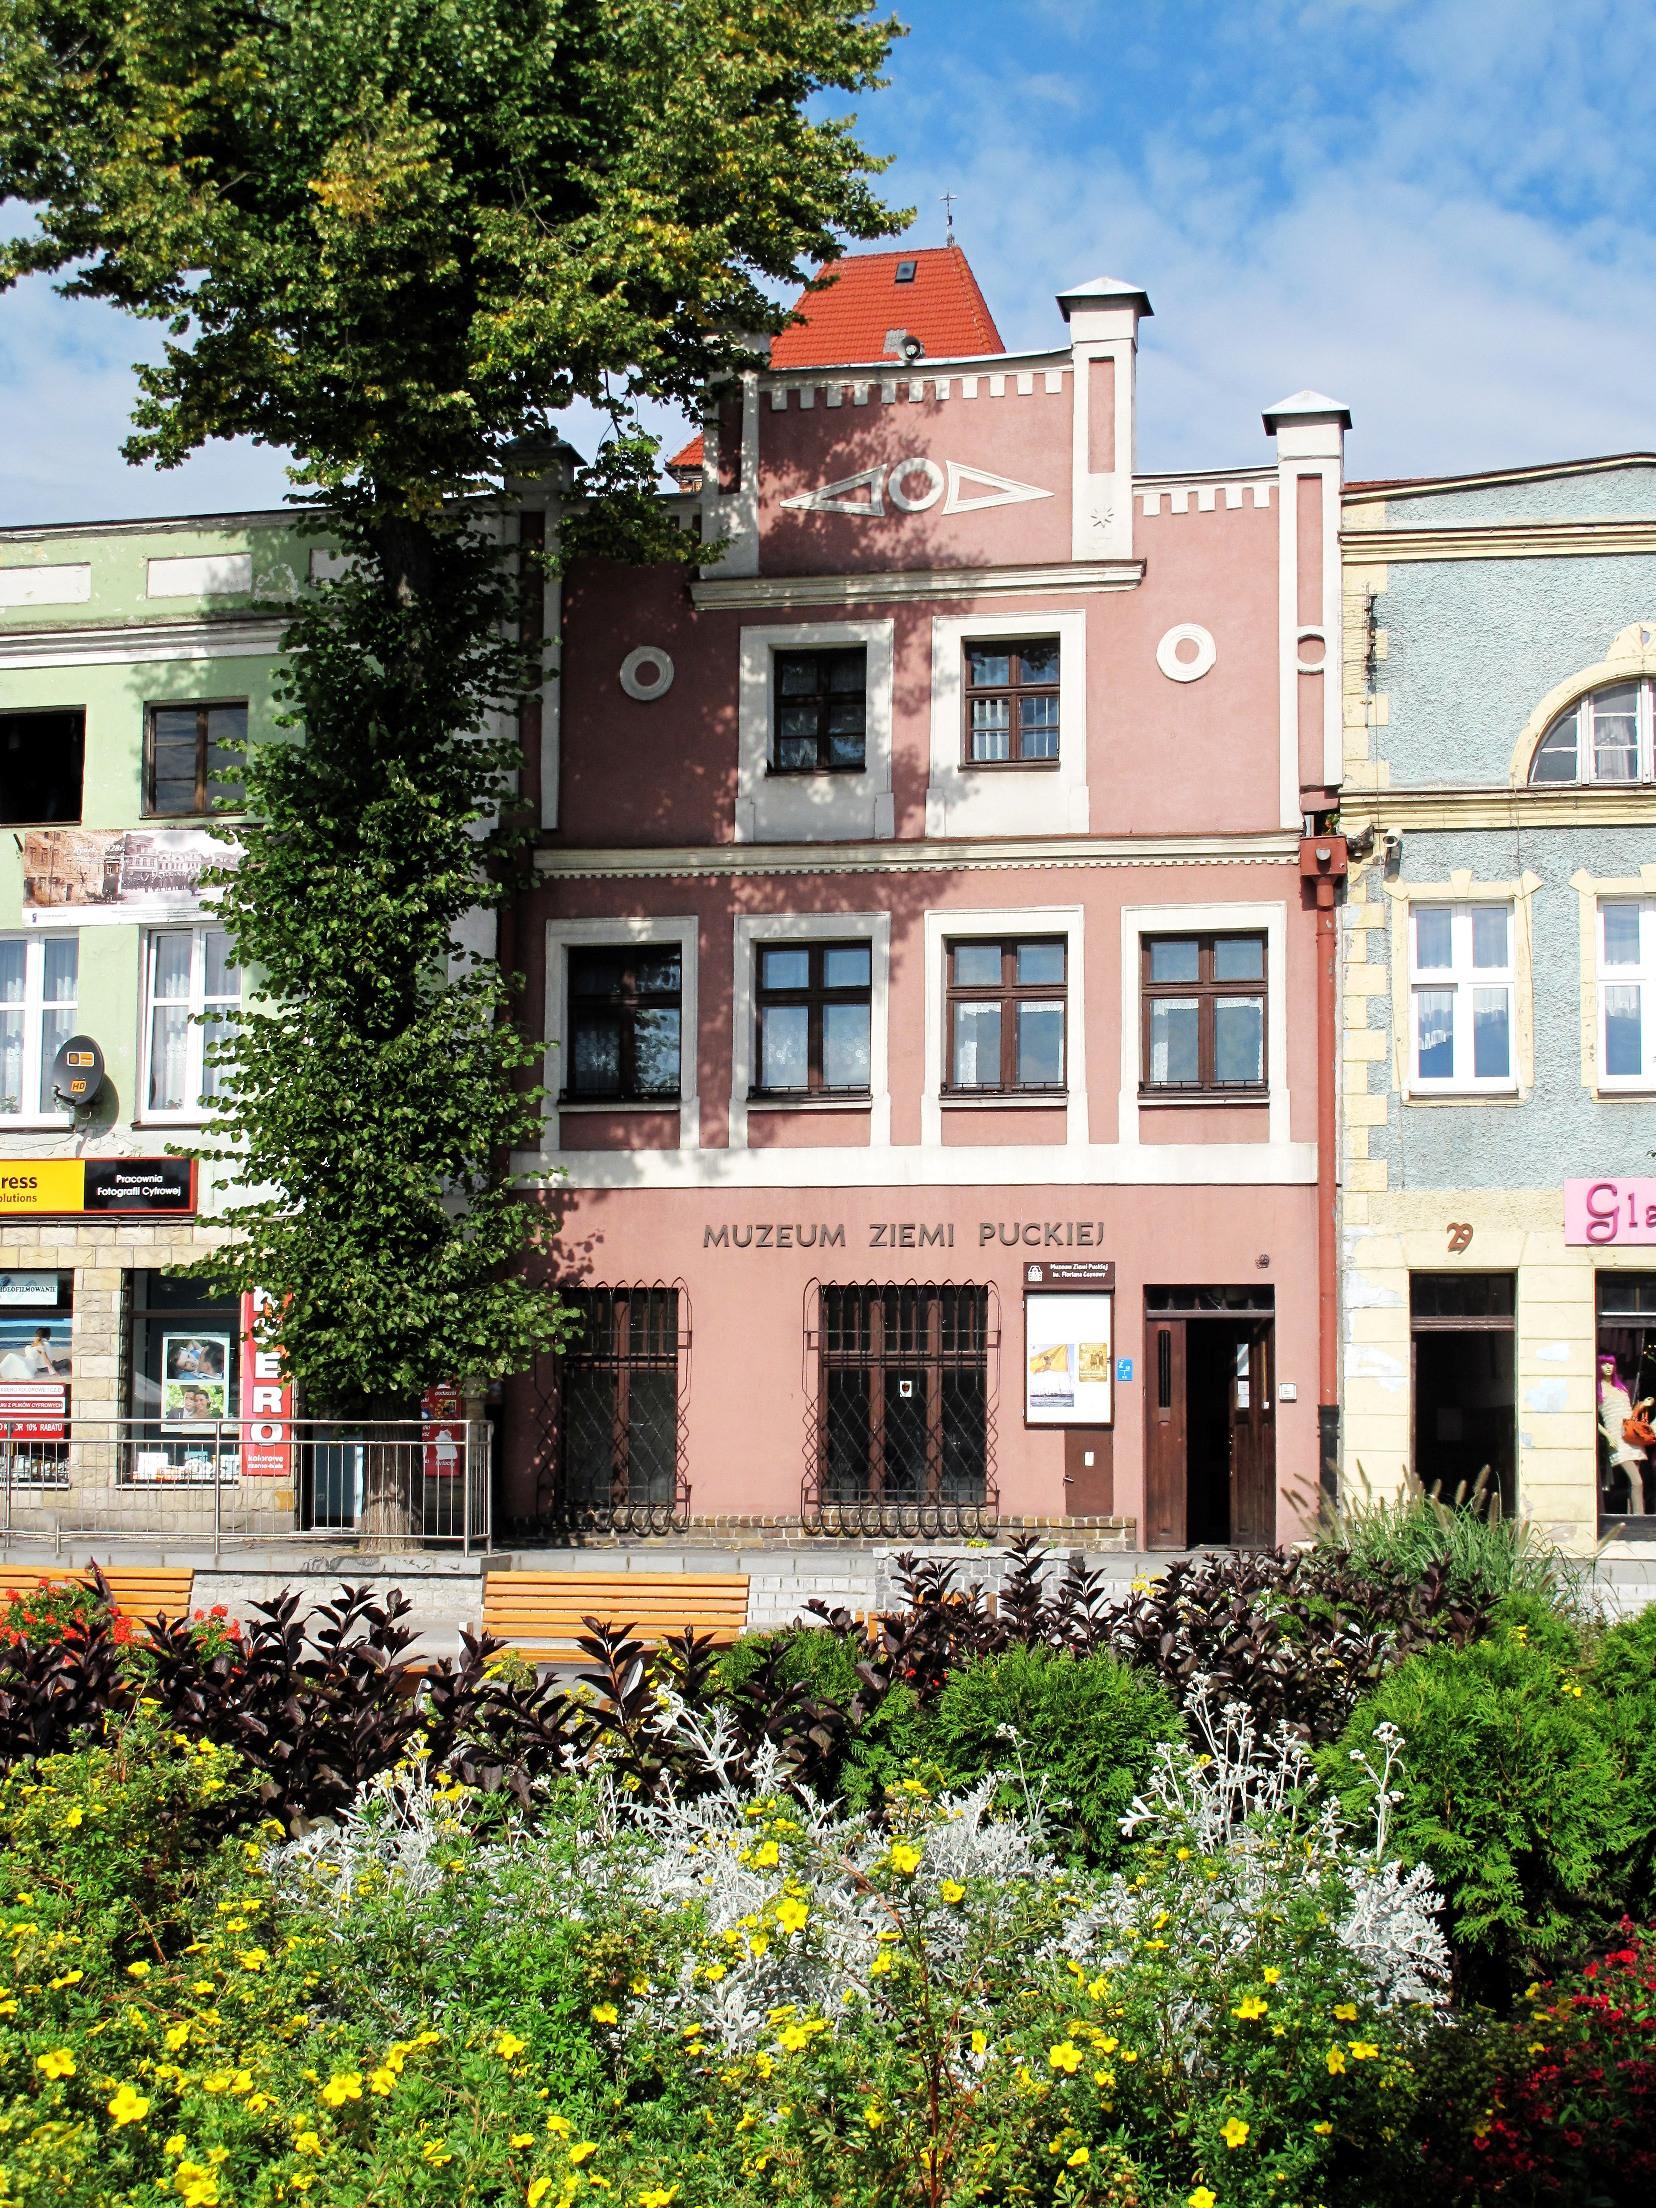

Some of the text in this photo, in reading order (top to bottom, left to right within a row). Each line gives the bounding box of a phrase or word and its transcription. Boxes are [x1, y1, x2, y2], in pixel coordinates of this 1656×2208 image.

[72, 1082, 85, 1091] HD
[1, 1176, 38, 1189] ress
[116, 1174, 163, 1183] Pracownia
[97, 1187, 181, 1198] Fotografii Cyfrowej
[703, 1222, 1106, 1248] MUZEUM ZIEMI PUCKIEJ
[1446, 1222, 1474, 1255] 29
[1088, 1263, 1109, 1271] Puckiej
